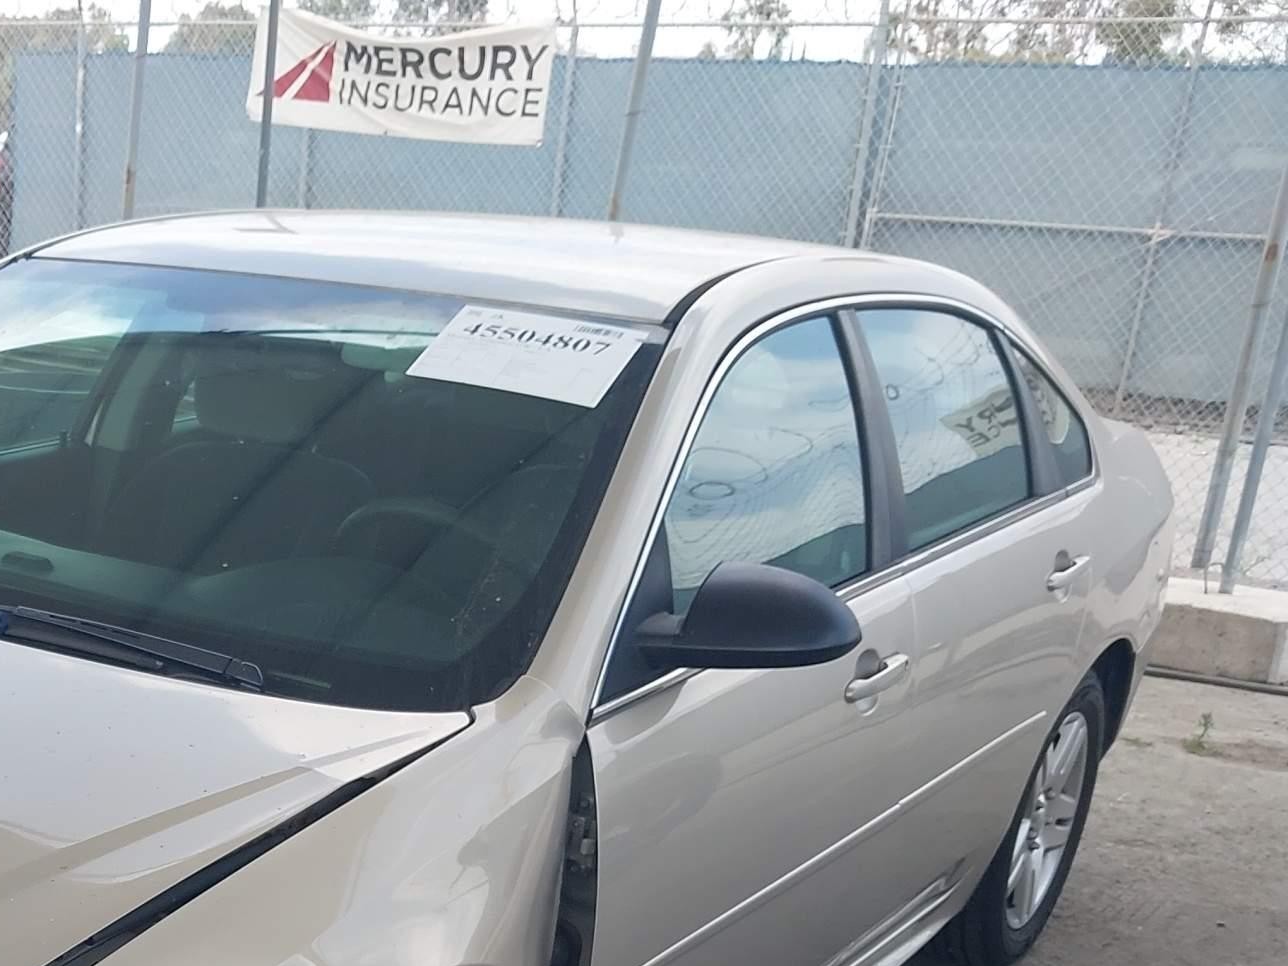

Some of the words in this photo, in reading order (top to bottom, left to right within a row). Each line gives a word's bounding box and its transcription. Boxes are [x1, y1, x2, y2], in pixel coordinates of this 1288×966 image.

[343, 41, 549, 81] MERCURY
[339, 79, 543, 117] INSURANCE
[463, 322, 611, 355] 45504807
